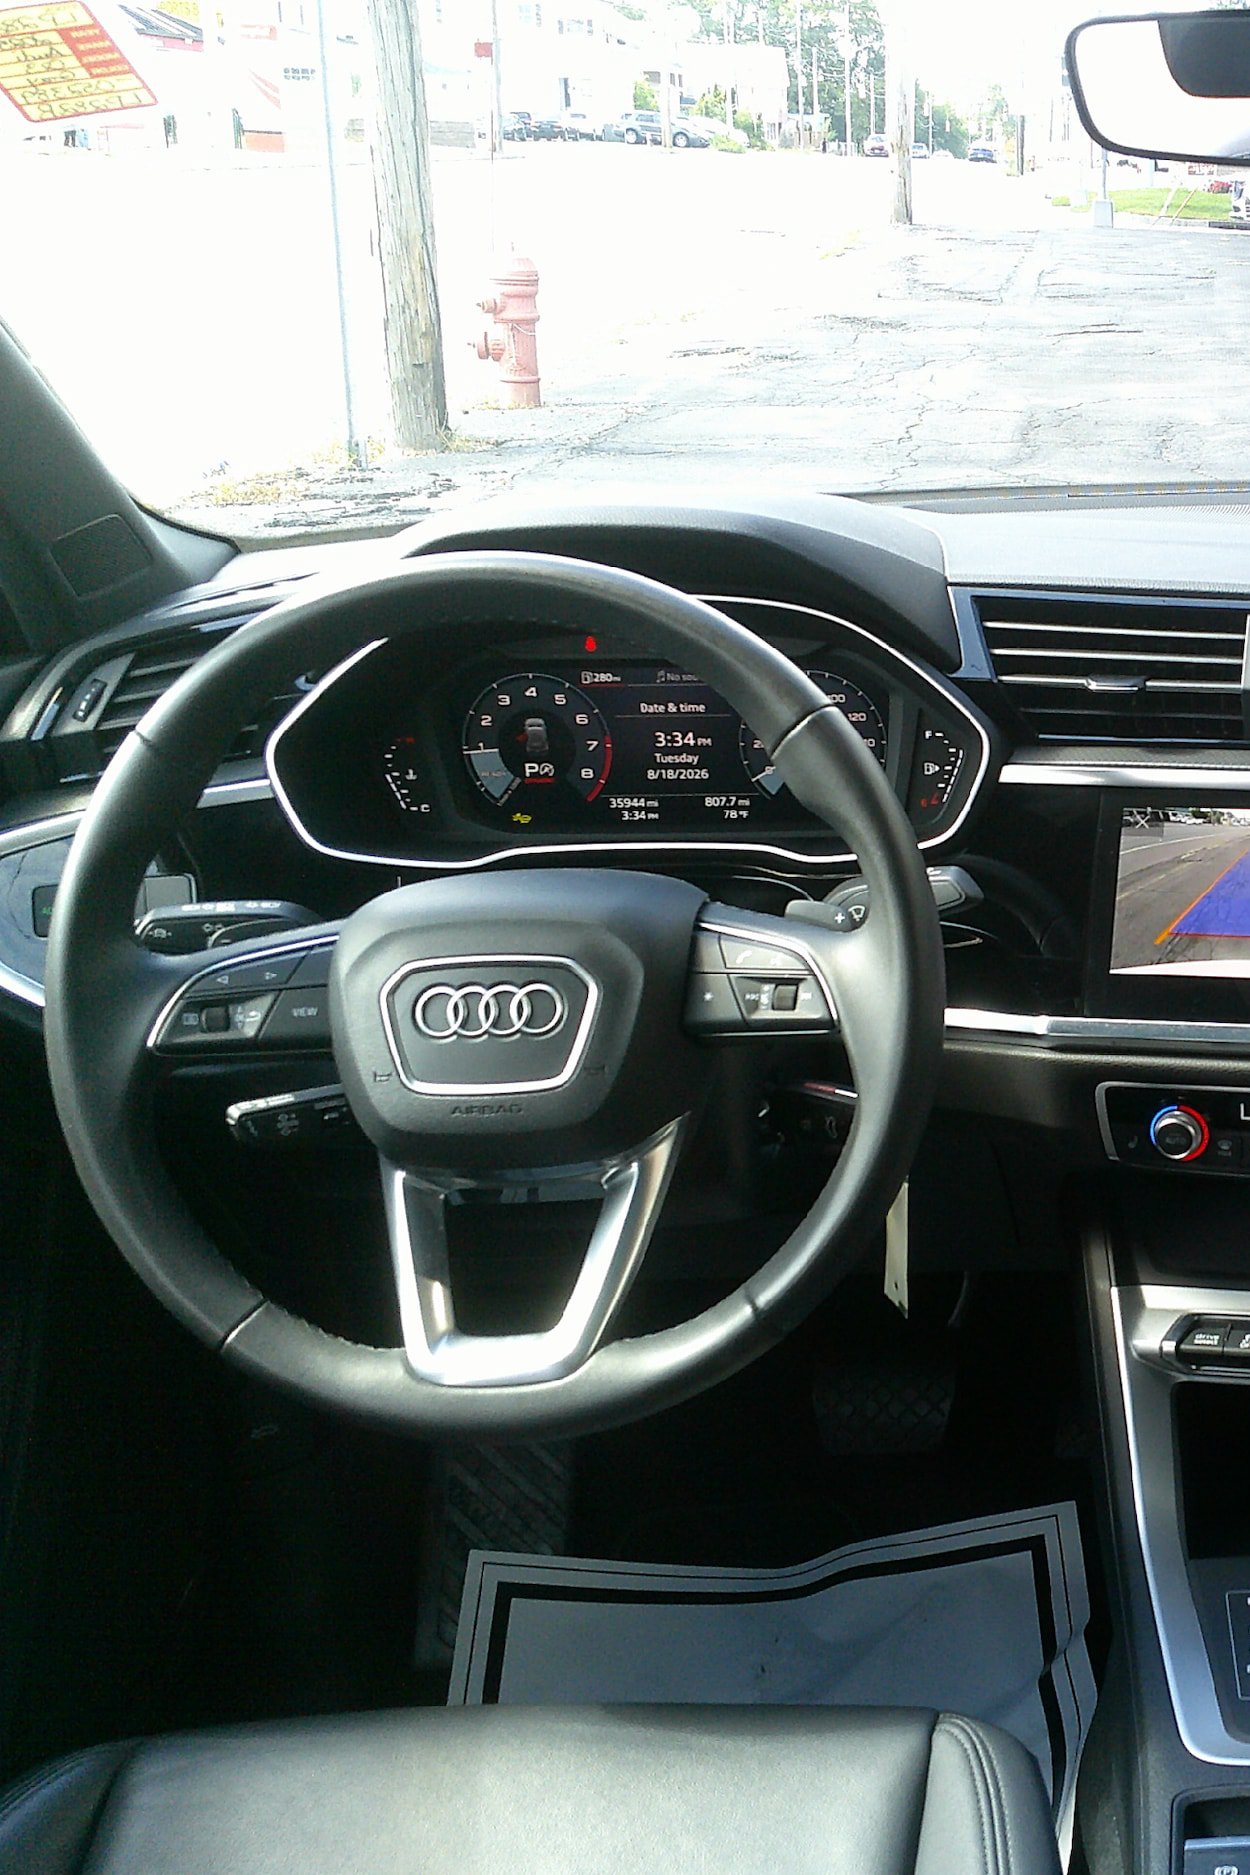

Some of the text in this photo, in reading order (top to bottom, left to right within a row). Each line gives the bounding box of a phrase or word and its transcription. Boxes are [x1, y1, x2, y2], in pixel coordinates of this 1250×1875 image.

[667, 673, 680, 681] No
[525, 687, 537, 697] 4
[498, 695, 511, 705] 3
[554, 694, 567, 705] 5
[640, 703, 706, 713] Date & time
[480, 715, 492, 726] 2
[575, 714, 589, 725] 6
[655, 731, 712, 747] 3:34 PM
[925, 730, 932, 739] F
[586, 740, 598, 751] 7
[654, 753, 699, 764] Tuesday
[524, 763, 538, 777] P
[581, 768, 594, 779] 8
[647, 768, 709, 780] 8/18/2026
[609, 798, 658, 808] 35944 mi
[705, 797, 750, 807] 807.7 mi
[420, 804, 430, 812] C
[622, 811, 646, 820] 3:34
[724, 810, 738, 819] 78
[292, 1007, 318, 1017] VIEW
[451, 1104, 523, 1116] AIRBAG
